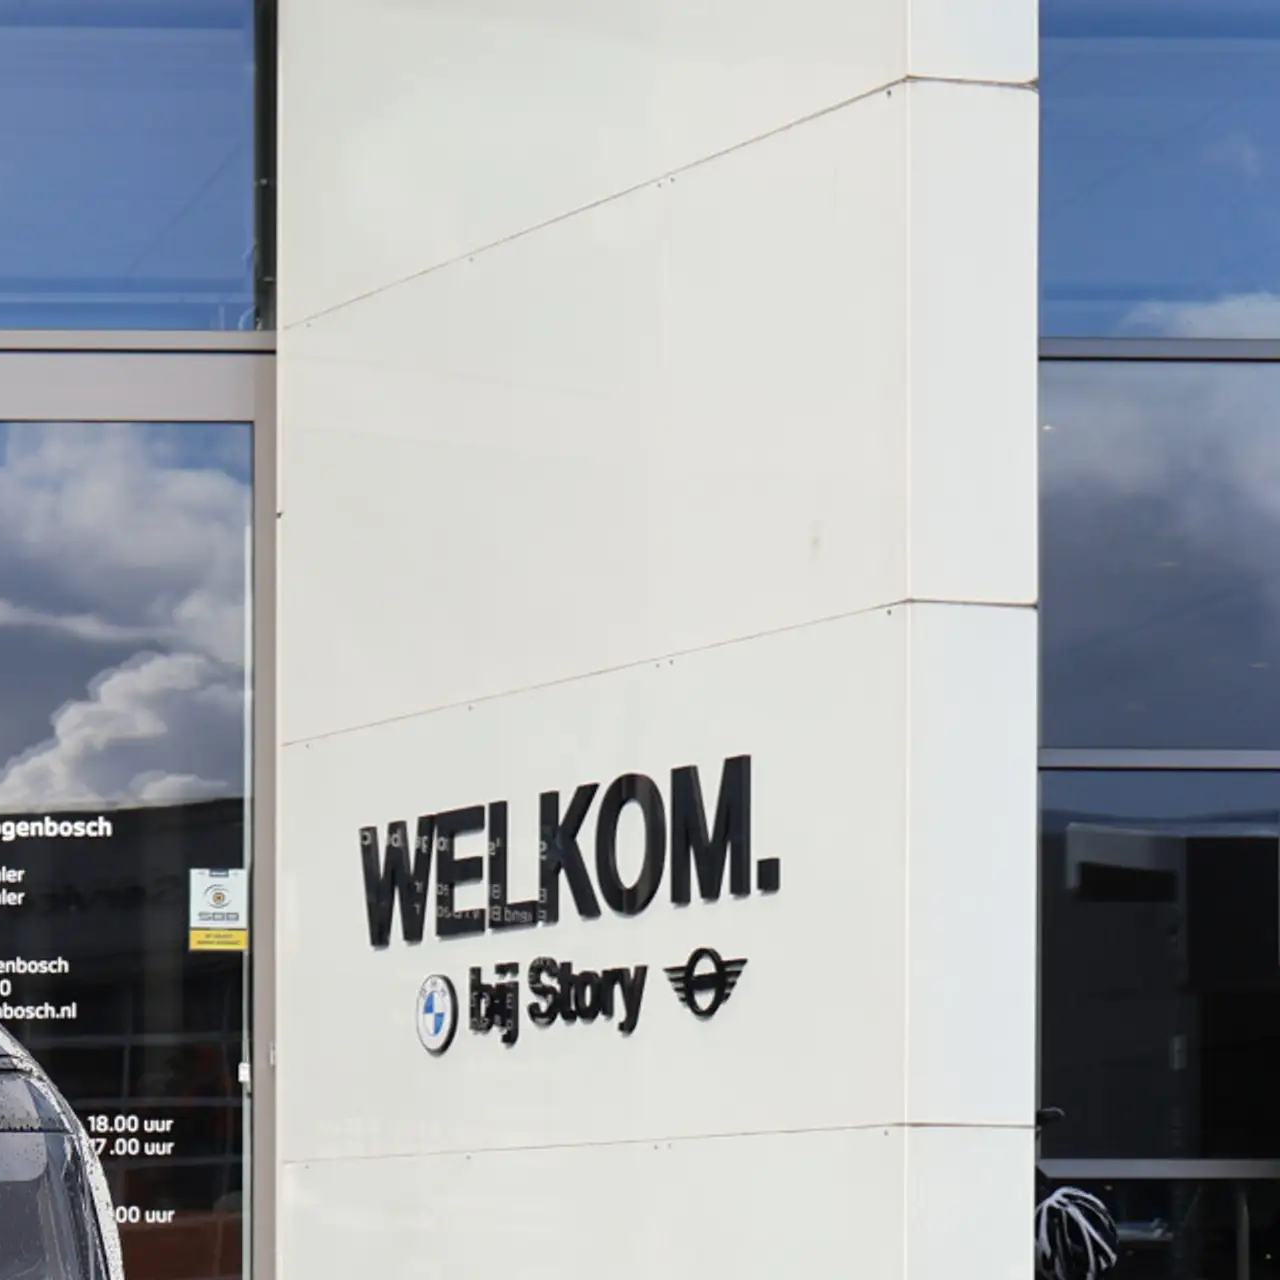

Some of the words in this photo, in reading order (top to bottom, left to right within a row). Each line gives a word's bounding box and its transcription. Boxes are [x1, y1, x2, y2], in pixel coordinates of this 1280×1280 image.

[359, 754, 781, 950] WELKOM.
[469, 961, 519, 1047] bij
[528, 957, 648, 1036] Story
[88, 1114, 139, 1132] 18.00
[143, 1119, 174, 1132] uur
[143, 1142, 175, 1155] uur
[144, 1210, 175, 1223] uur
